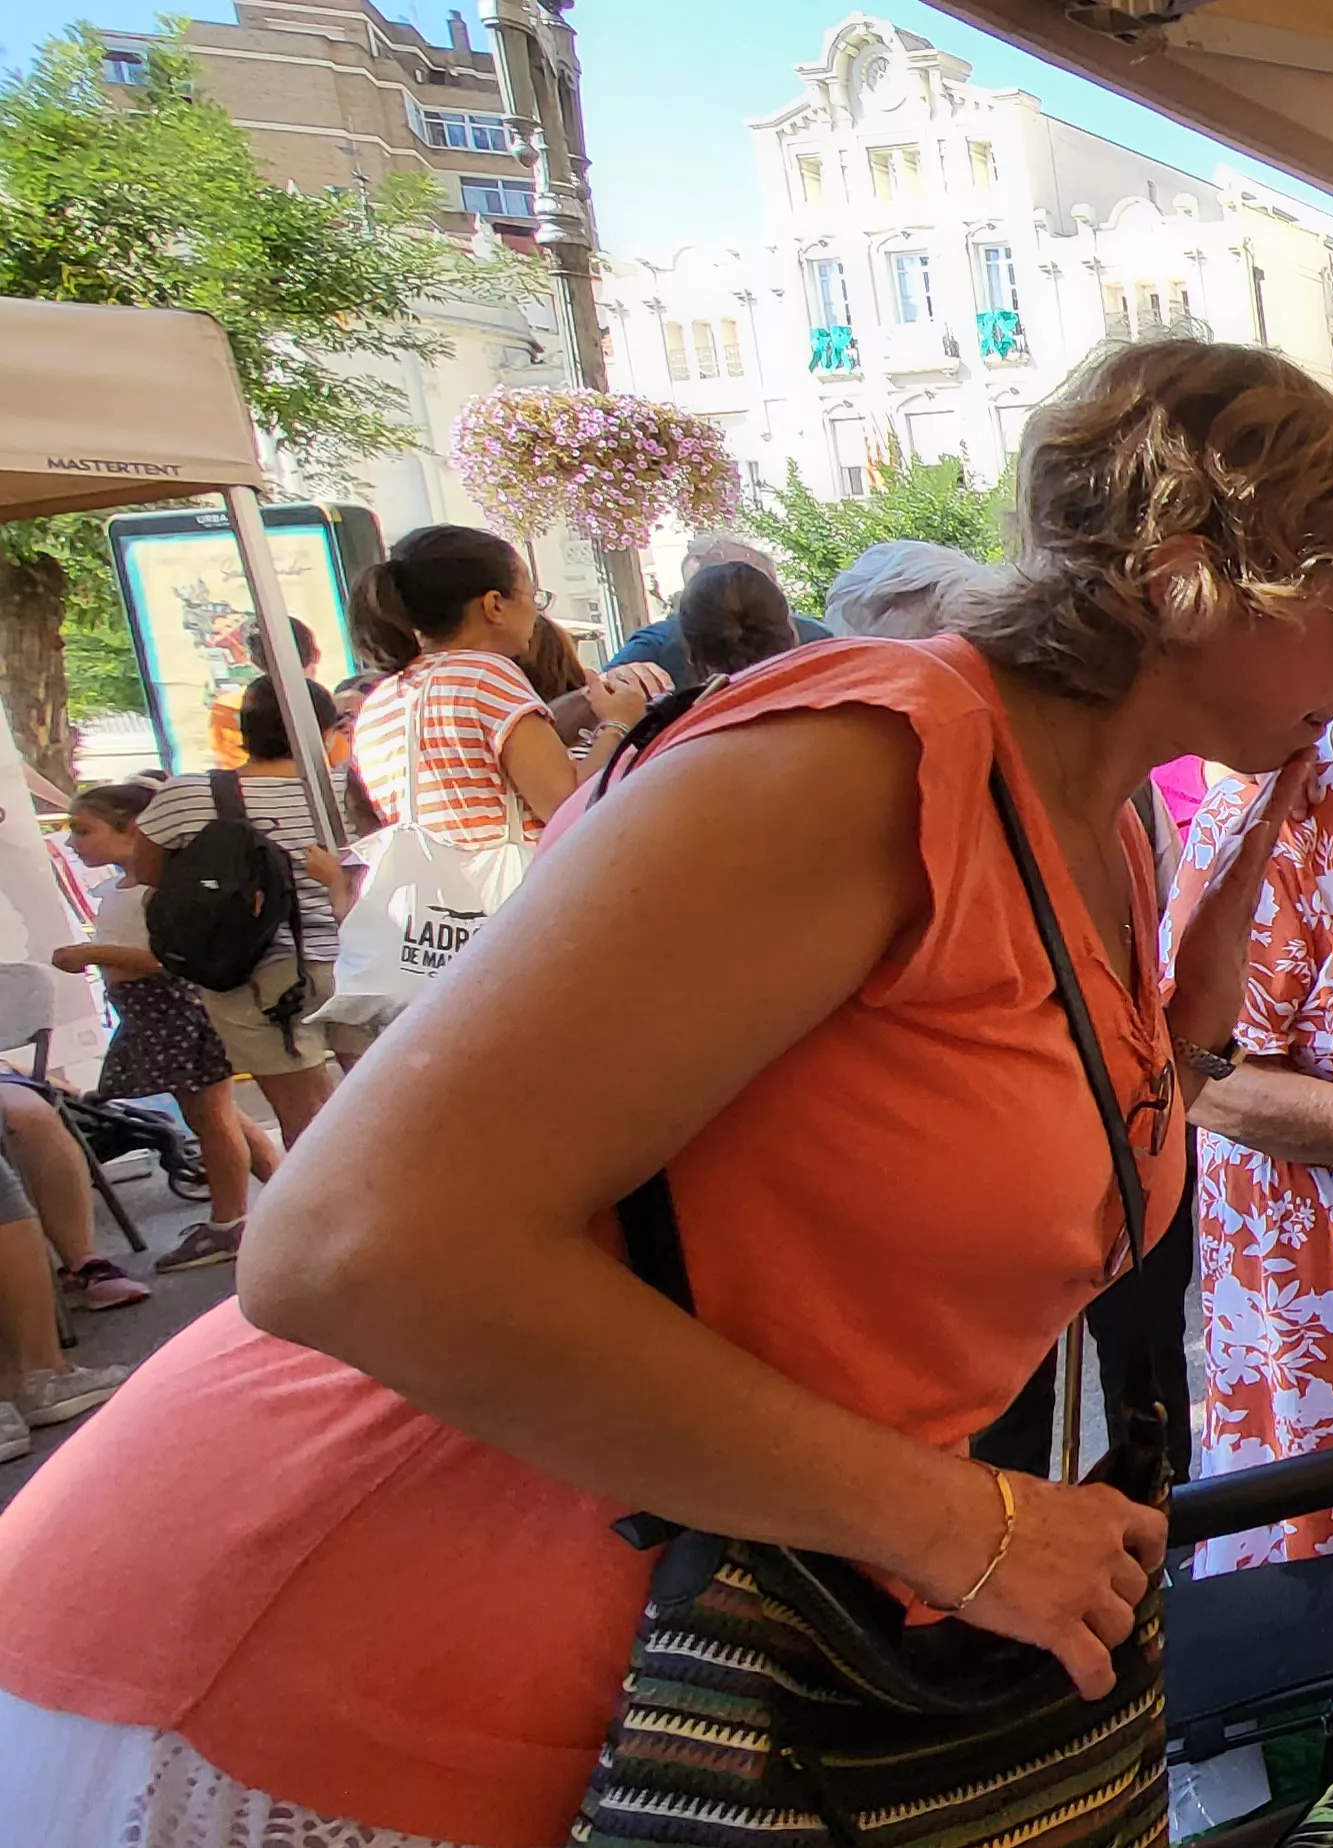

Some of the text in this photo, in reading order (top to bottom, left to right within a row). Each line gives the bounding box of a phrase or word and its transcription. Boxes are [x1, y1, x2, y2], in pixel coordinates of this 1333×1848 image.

[47, 457, 182, 477] MASTERTENT
[404, 914, 480, 952] LADR
[401, 945, 452, 969] DE MA
